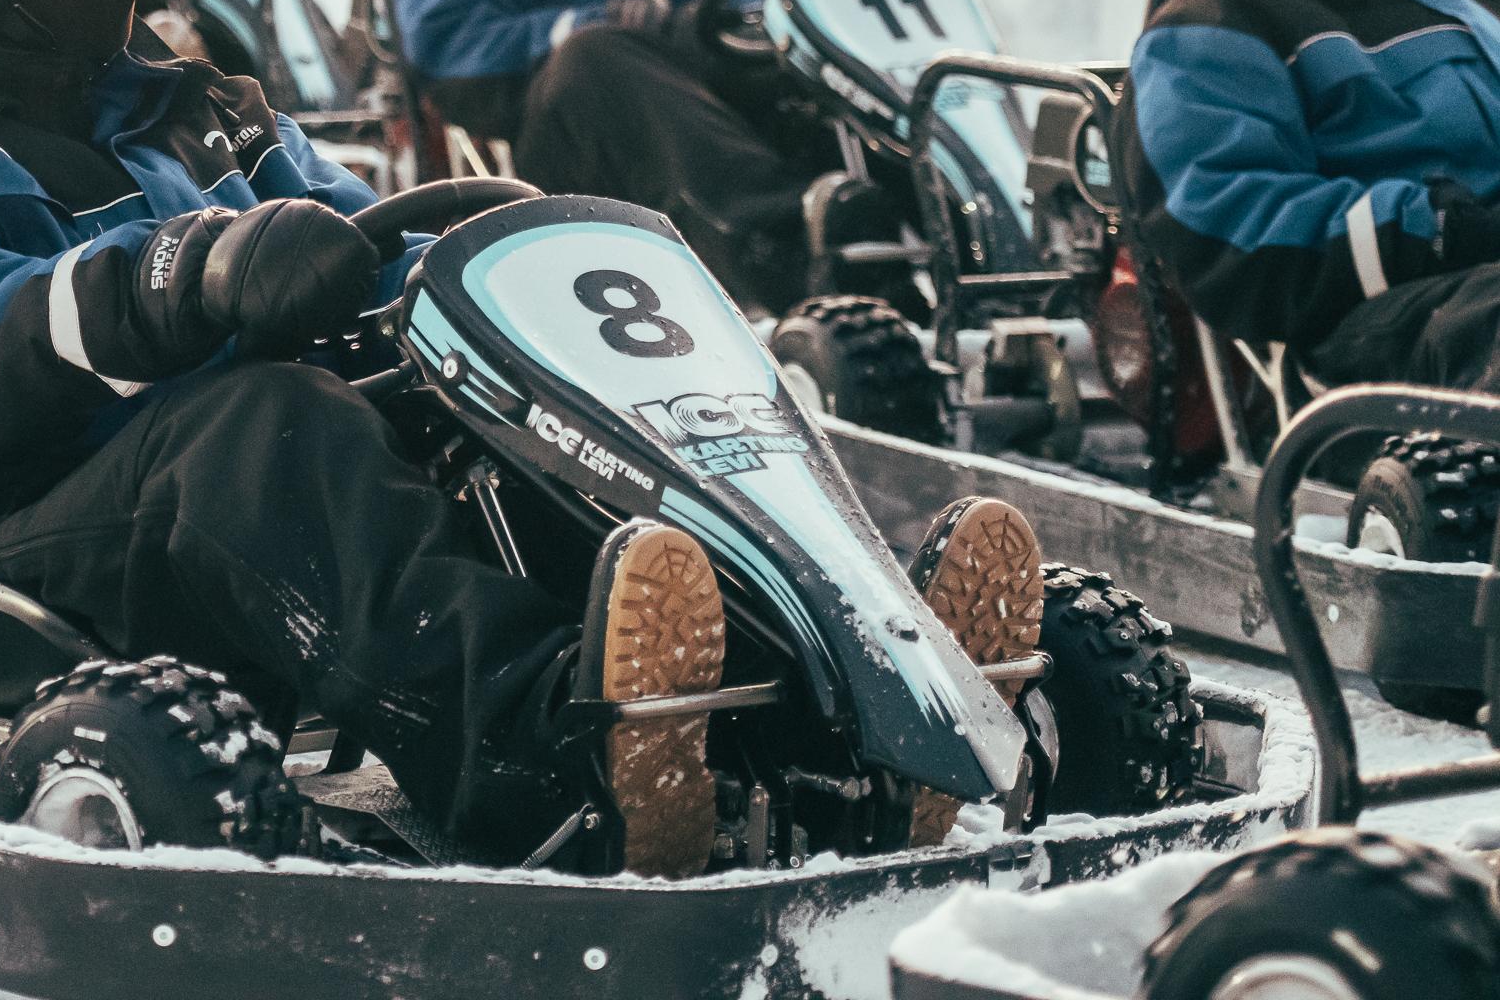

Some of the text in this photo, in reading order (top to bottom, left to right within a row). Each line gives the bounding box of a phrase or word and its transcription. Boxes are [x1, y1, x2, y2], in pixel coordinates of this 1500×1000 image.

[573, 269, 695, 358] 8
[632, 393, 793, 445] ICE
[525, 403, 655, 491] ICE KARTING
[579, 450, 615, 481] LEVI
[675, 435, 809, 462] KARTING
[687, 452, 763, 477] LEVI
